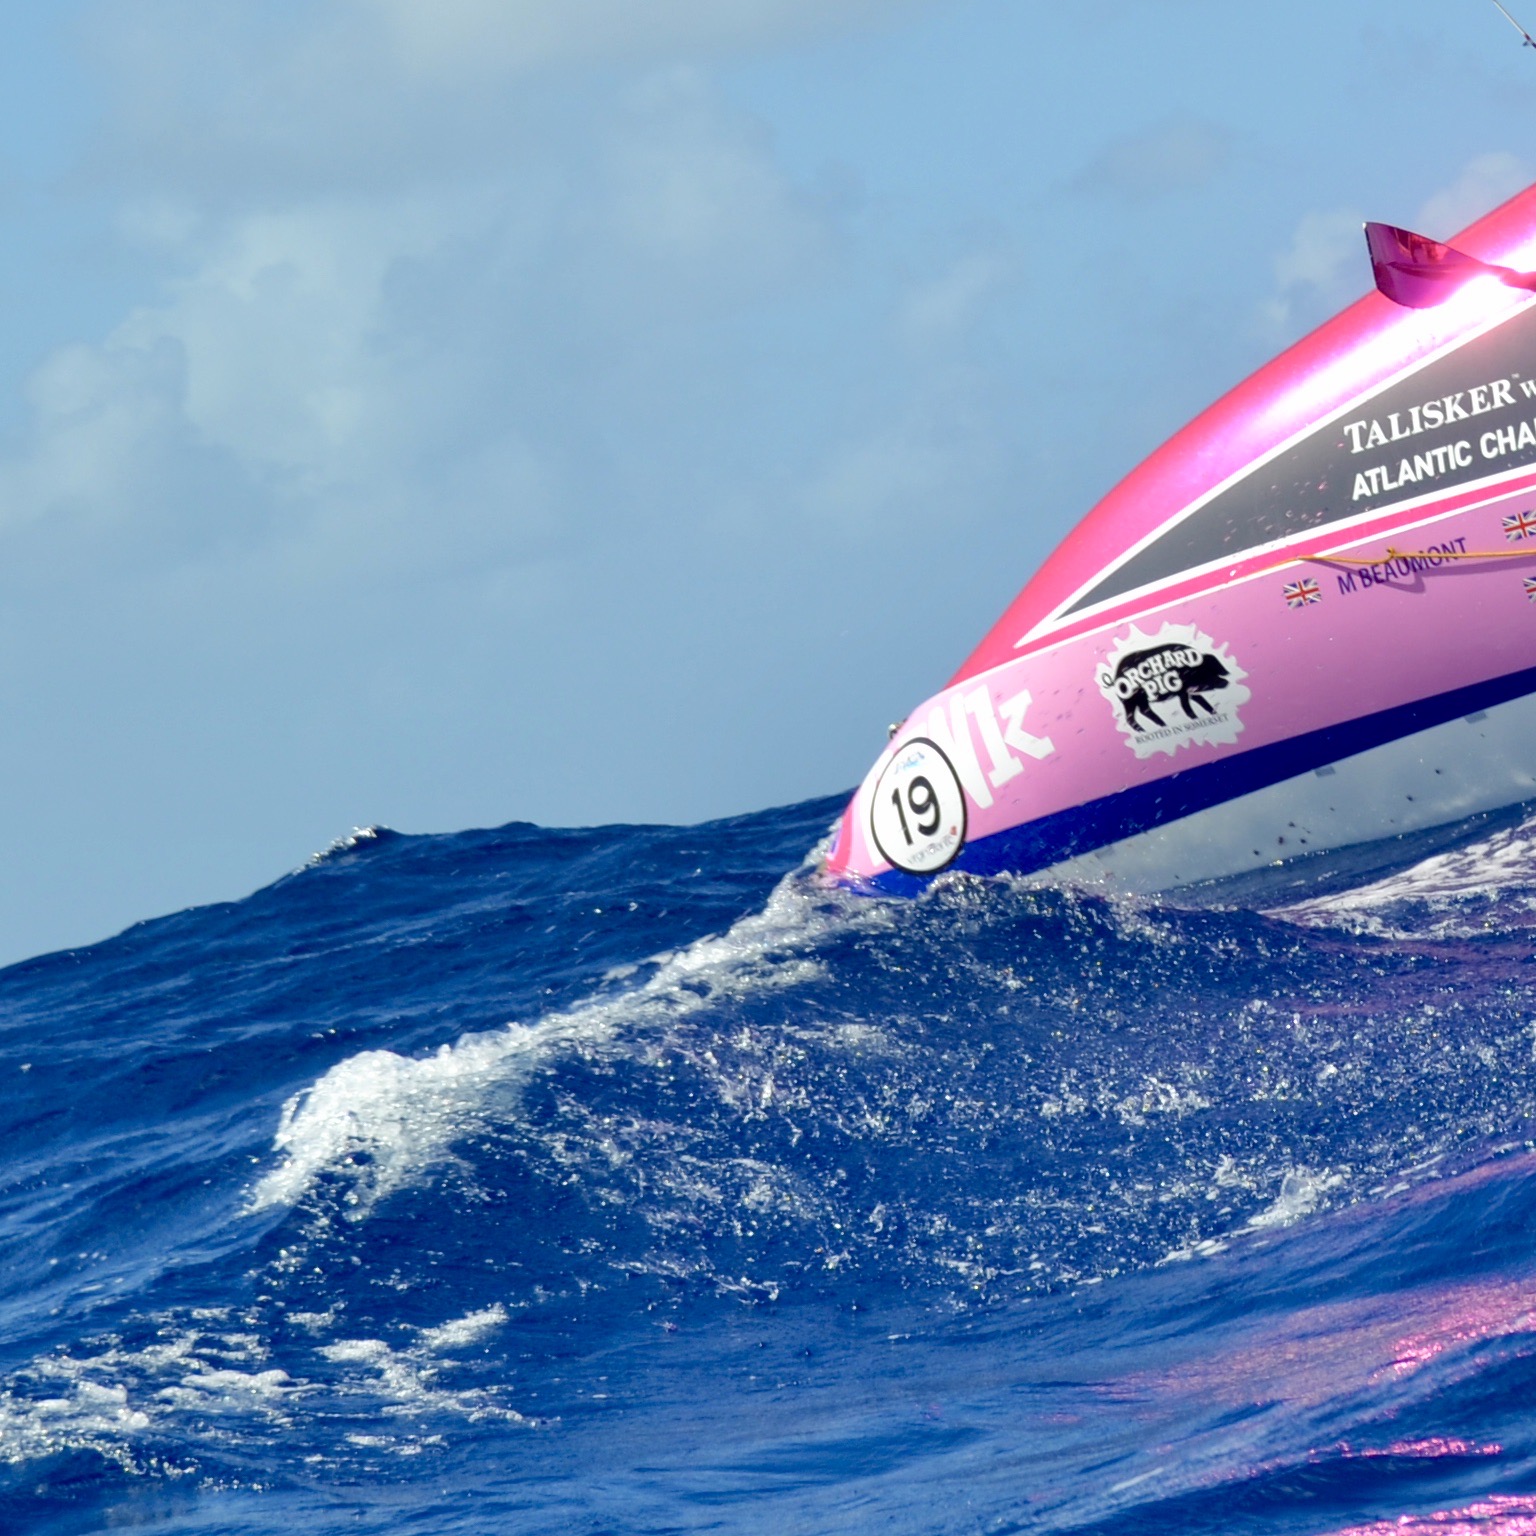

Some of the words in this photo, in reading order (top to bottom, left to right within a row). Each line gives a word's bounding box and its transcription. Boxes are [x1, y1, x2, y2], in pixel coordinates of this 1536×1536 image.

[1352, 440, 1473, 501] ATLANTIC
[1337, 574, 1357, 595] M
[1358, 537, 1467, 590] BEAUMONT
[1114, 648, 1203, 700] ORCHARD
[1141, 670, 1183, 701] PIG
[1134, 728, 1171, 744] ROOTED
[1171, 724, 1183, 735] IN
[891, 775, 941, 846] 19
